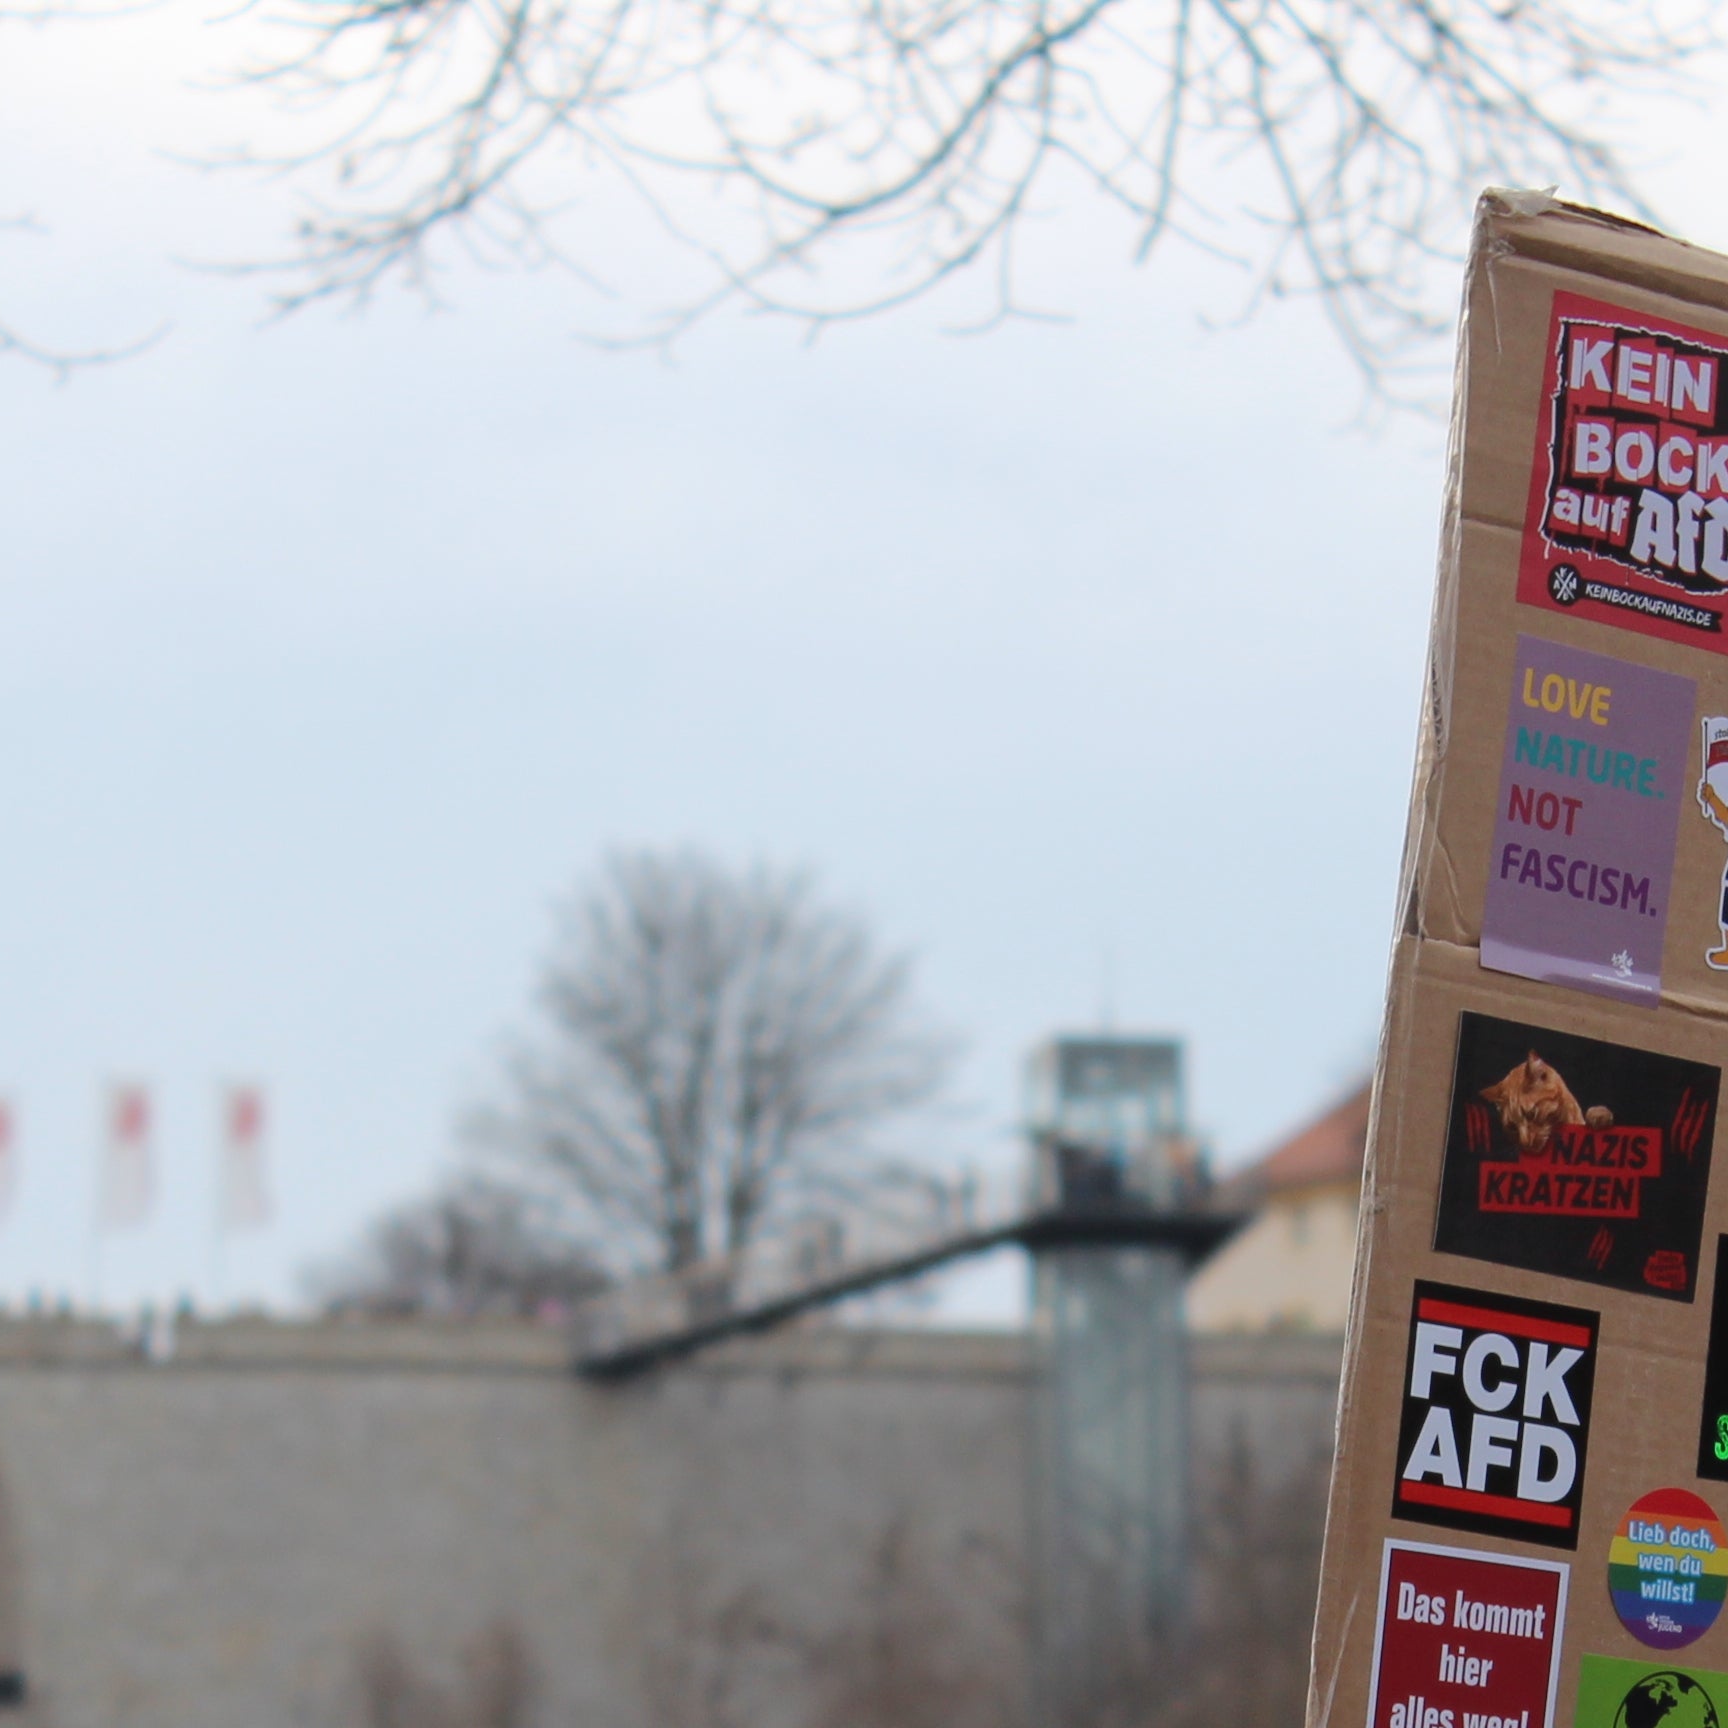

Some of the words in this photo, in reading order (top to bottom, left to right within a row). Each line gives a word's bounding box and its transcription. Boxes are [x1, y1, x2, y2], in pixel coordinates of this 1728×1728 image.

[1570, 339, 1713, 413] KEIN
[1553, 488, 1630, 534] auf
[1586, 583, 1711, 626] KEINBOCKAUFNAZIS.DE
[1522, 668, 1611, 726] LOVE
[1515, 727, 1665, 800] NATURE.
[1507, 785, 1583, 836] NOT
[1500, 843, 1657, 918] FASCISM.
[1551, 1132, 1649, 1170] NAZIS
[1483, 1169, 1637, 1210] KRATZEN
[1410, 1322, 1585, 1425] FCK
[1402, 1406, 1577, 1503] AFD
[1628, 1521, 1663, 1544] Lieb
[1669, 1526, 1716, 1551] doch,
[1638, 1553, 1676, 1571] wen
[1679, 1555, 1702, 1576] du
[1397, 1582, 1446, 1625] Das
[1454, 1590, 1545, 1639] kommt
[1640, 1579, 1694, 1603] willst!
[1439, 1644, 1493, 1687] hier
